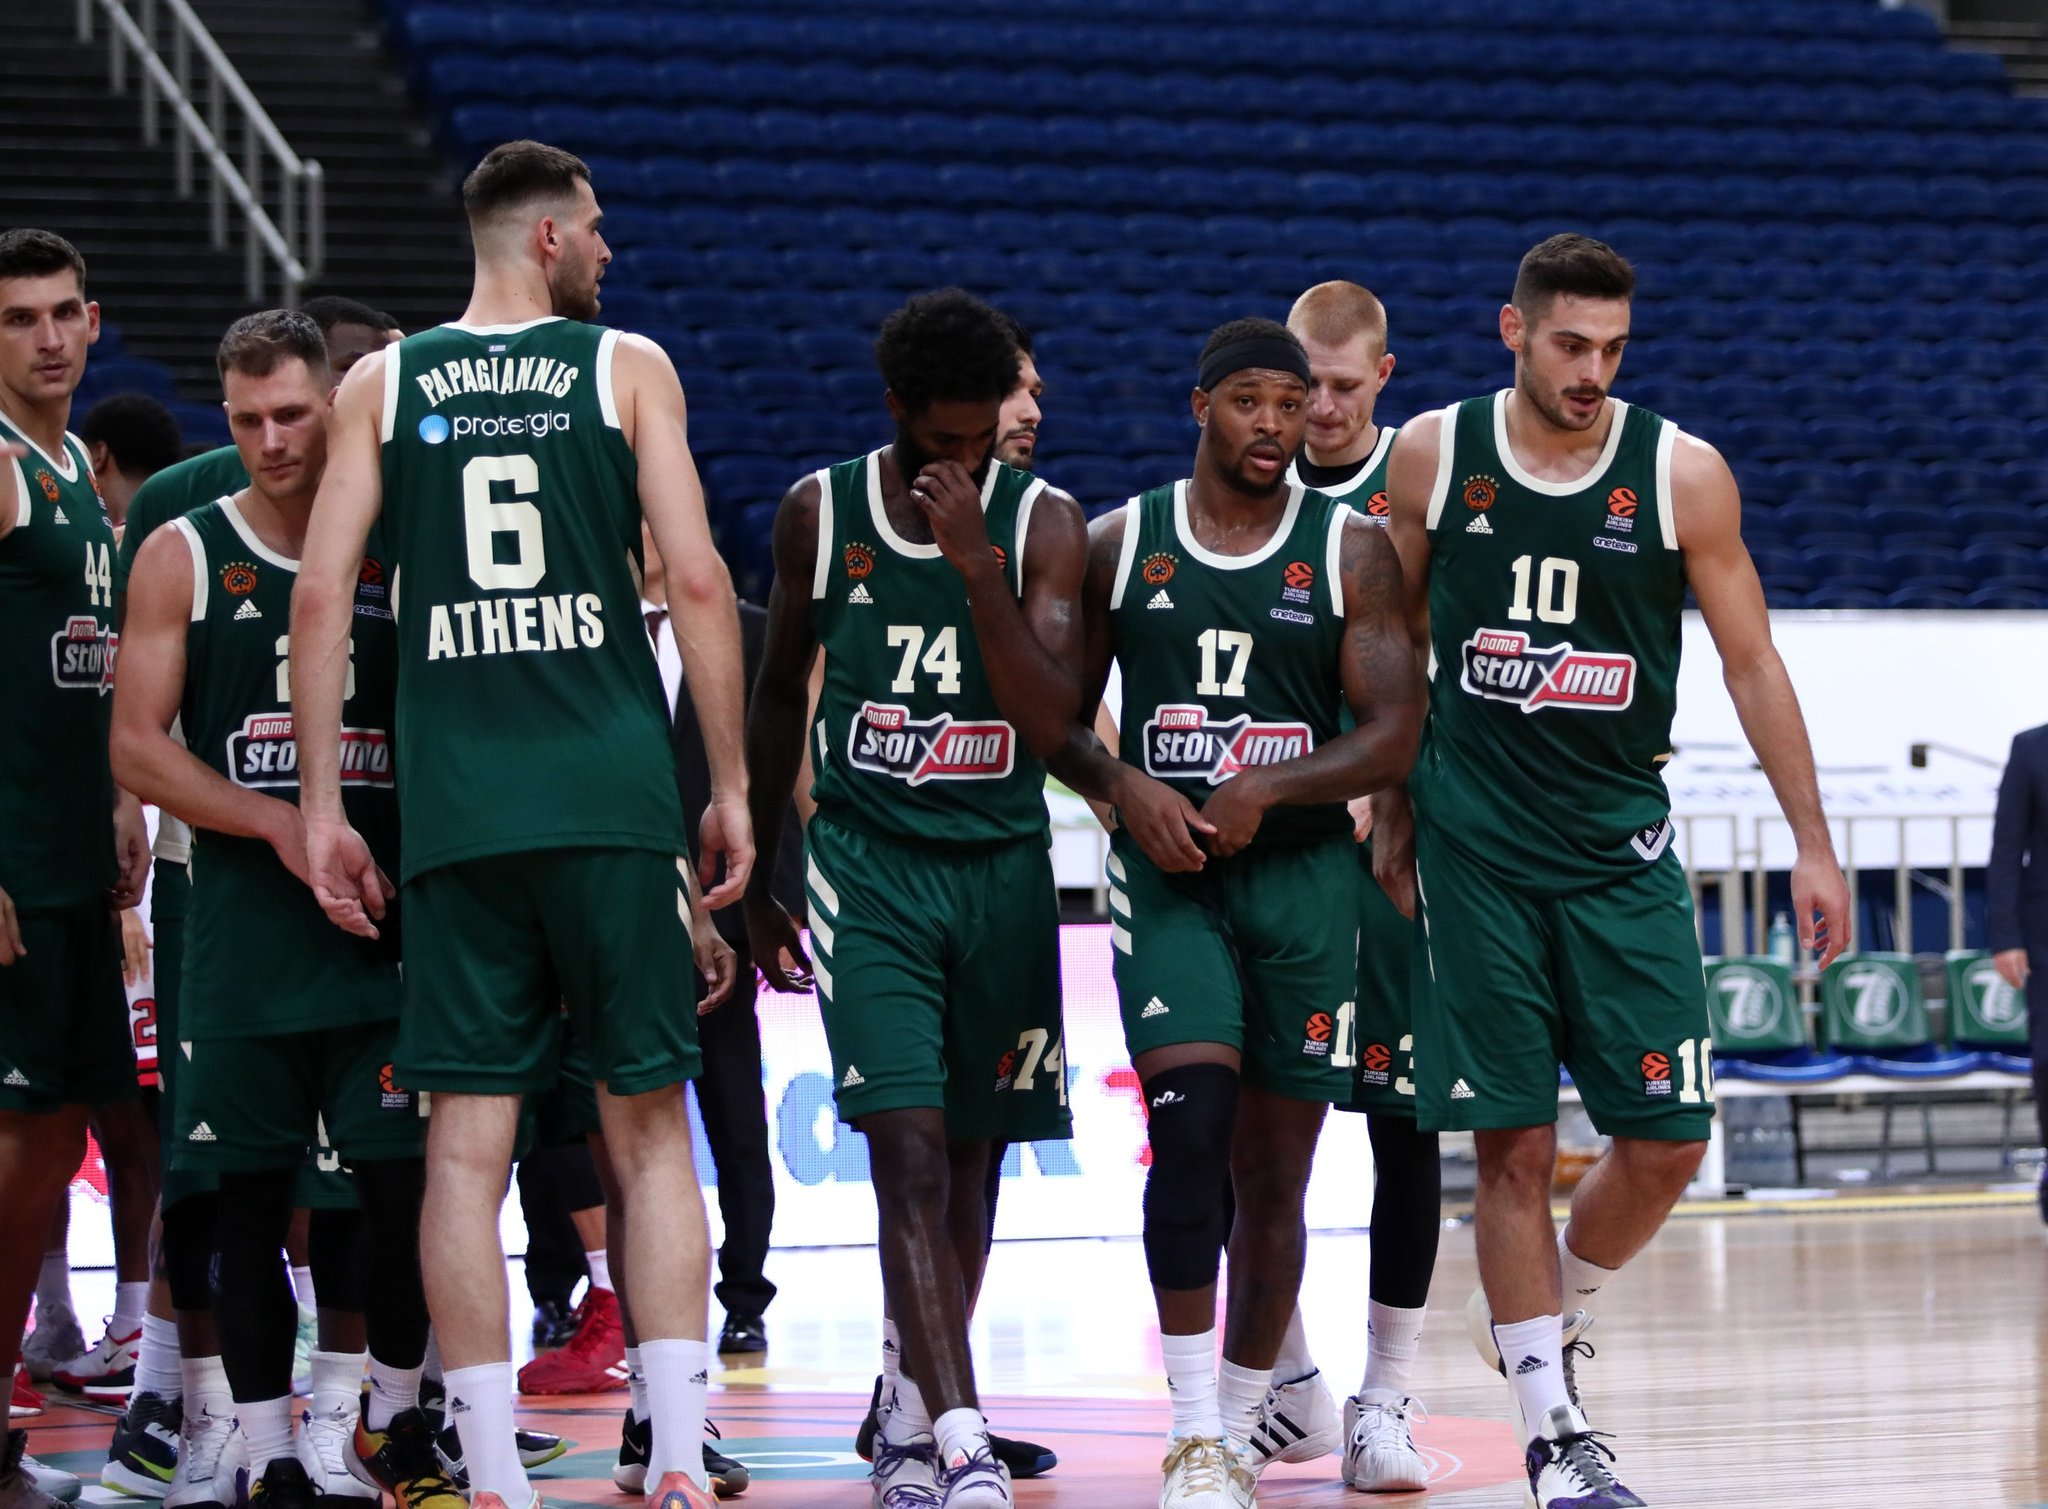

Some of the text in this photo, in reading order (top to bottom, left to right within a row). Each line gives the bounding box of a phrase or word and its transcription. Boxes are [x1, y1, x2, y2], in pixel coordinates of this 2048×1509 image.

[416, 356, 579, 407] PAPAGIANNIS
[453, 410, 570, 440] protergia
[463, 454, 546, 590] 6
[1606, 515, 1634, 524] TURKISH
[1465, 526, 1494, 535] adidas
[1593, 536, 1638, 554] oneteam
[85, 541, 112, 607] 44
[1508, 554, 1580, 624] 10
[1147, 601, 1175, 609] adidas
[234, 610, 263, 621] adidas
[1270, 608, 1314, 625] oneteam
[428, 593, 605, 661] ATHENS
[1479, 636, 1519, 652] pame
[887, 625, 961, 694] 74
[1196, 628, 1254, 697] 17
[1162, 708, 1198, 727] pame
[253, 721, 292, 738] pame
[1141, 1005, 1170, 1019] adidas
[133, 998, 157, 1047] 2
[4, 1077, 30, 1085] adidas
[843, 1076, 865, 1087] adidas
[1450, 1089, 1476, 1099] adidas
[189, 1133, 217, 1141] adidas
[1515, 1360, 1549, 1376] adidas
